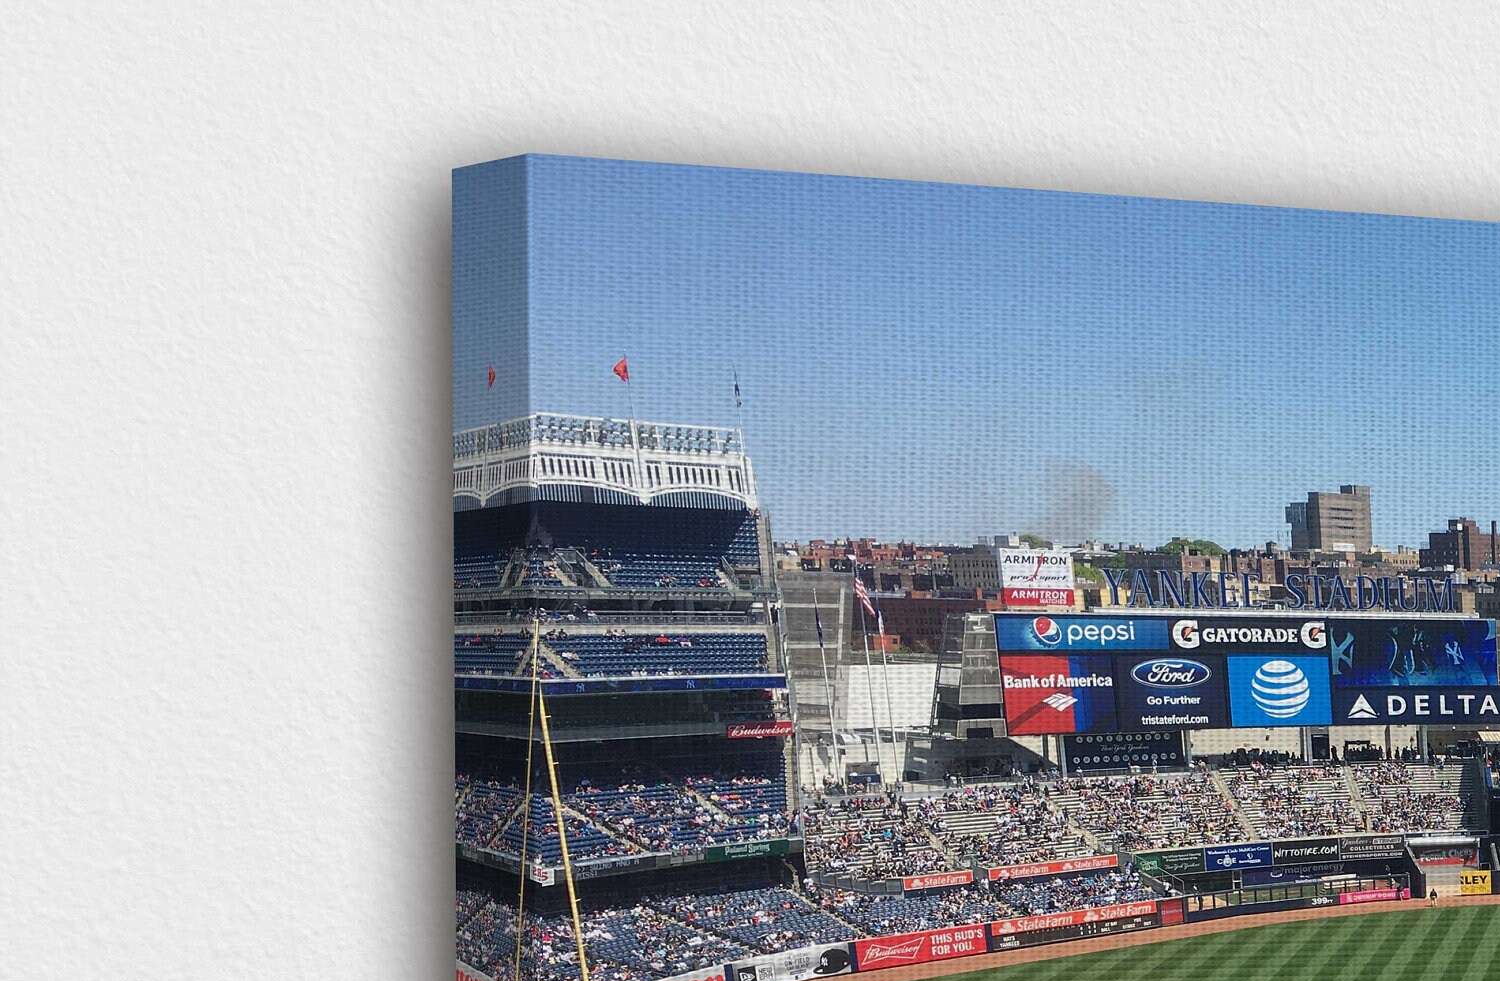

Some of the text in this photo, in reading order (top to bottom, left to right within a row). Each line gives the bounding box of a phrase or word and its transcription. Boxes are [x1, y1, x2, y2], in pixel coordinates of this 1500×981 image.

[1004, 554, 1067, 566] ARMITRON
[1011, 590, 1067, 599] ARMITRON
[1100, 568, 1456, 613] YANKEE STADIUM
[1067, 621, 1135, 645] pepsi
[1202, 627, 1298, 644] GATORADE
[1147, 662, 1197, 684] Ford
[1004, 673, 1113, 689] Bank of America
[1147, 695, 1201, 705] Go Further
[1387, 695, 1500, 716] DELTA
[1142, 714, 1209, 726] tristateford.com
[732, 723, 793, 738] Budweiser
[1274, 844, 1338, 858] NITTOTIRE.COM
[1349, 844, 1395, 852] COLLECTIBLES
[930, 929, 983, 945] THIS BUD'S
[865, 945, 920, 959] Budweiser
[931, 941, 976, 956] FOR YOU.
